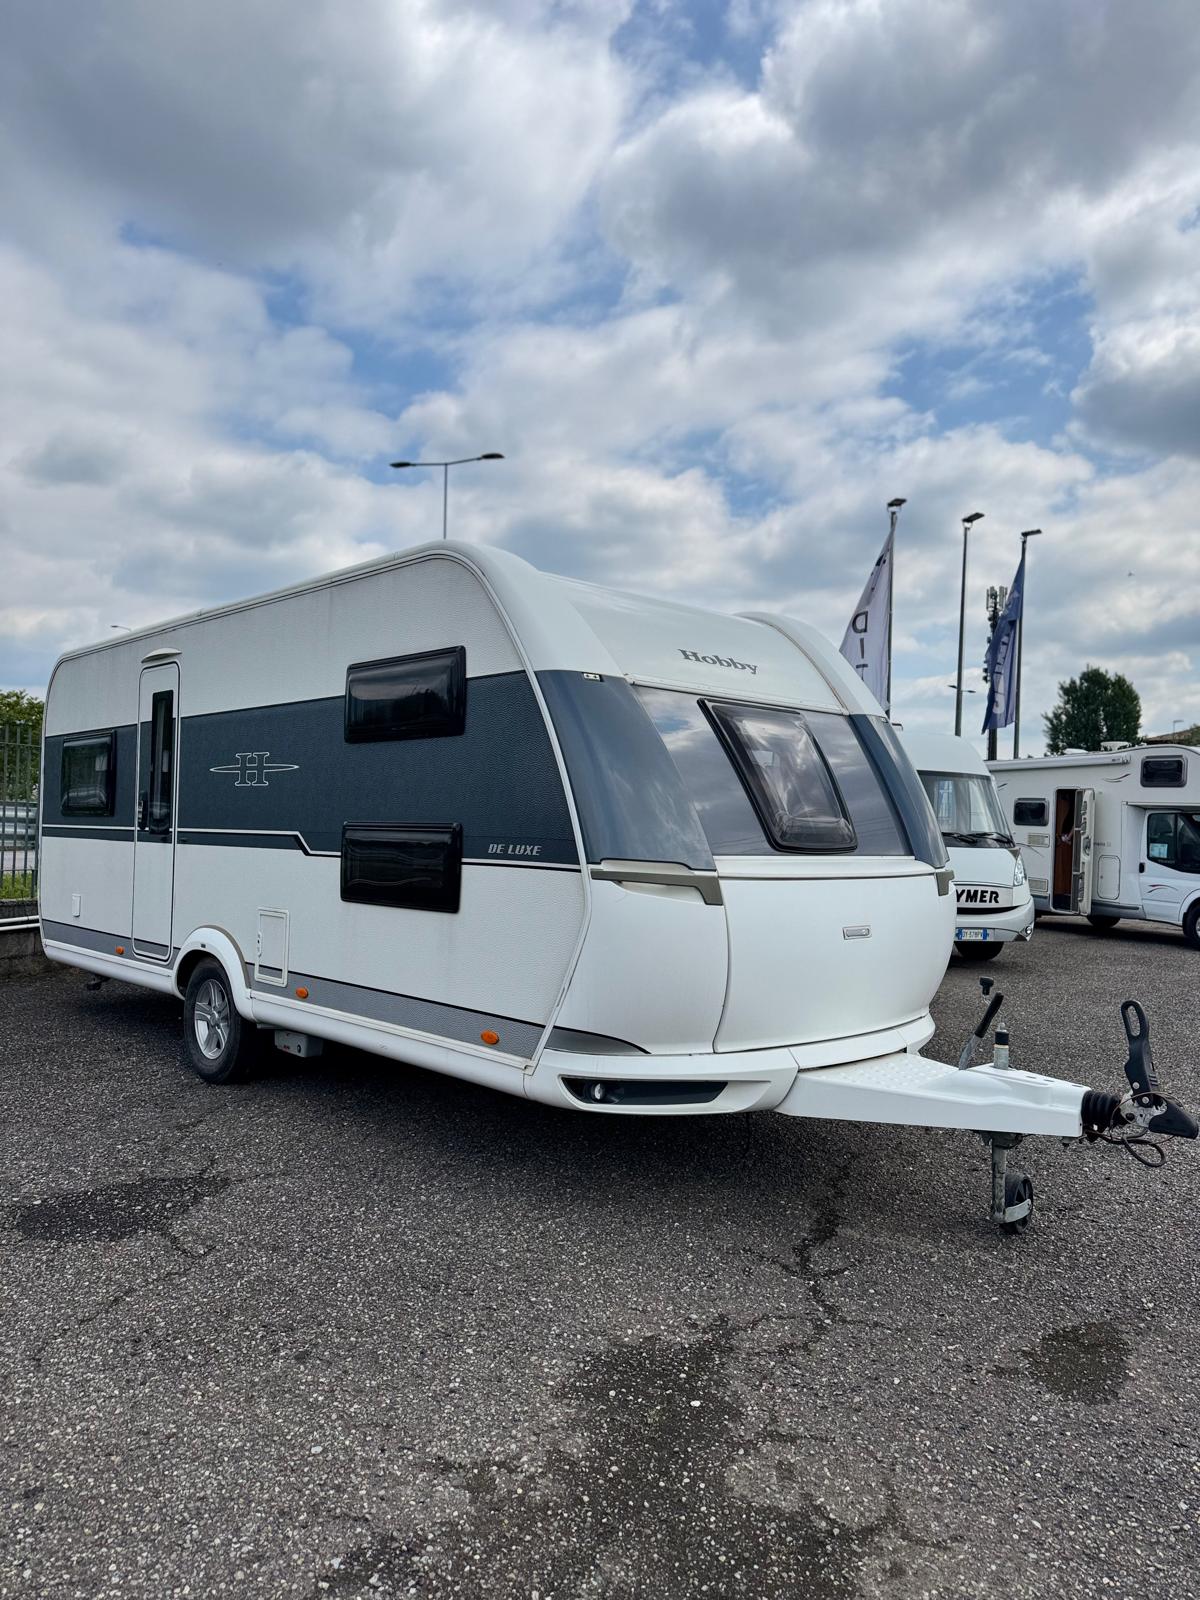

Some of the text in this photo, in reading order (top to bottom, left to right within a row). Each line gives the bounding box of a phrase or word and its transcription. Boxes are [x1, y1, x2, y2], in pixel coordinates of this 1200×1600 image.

[677, 648, 758, 675] Hobby
[487, 843, 542, 856] DE LUXE
